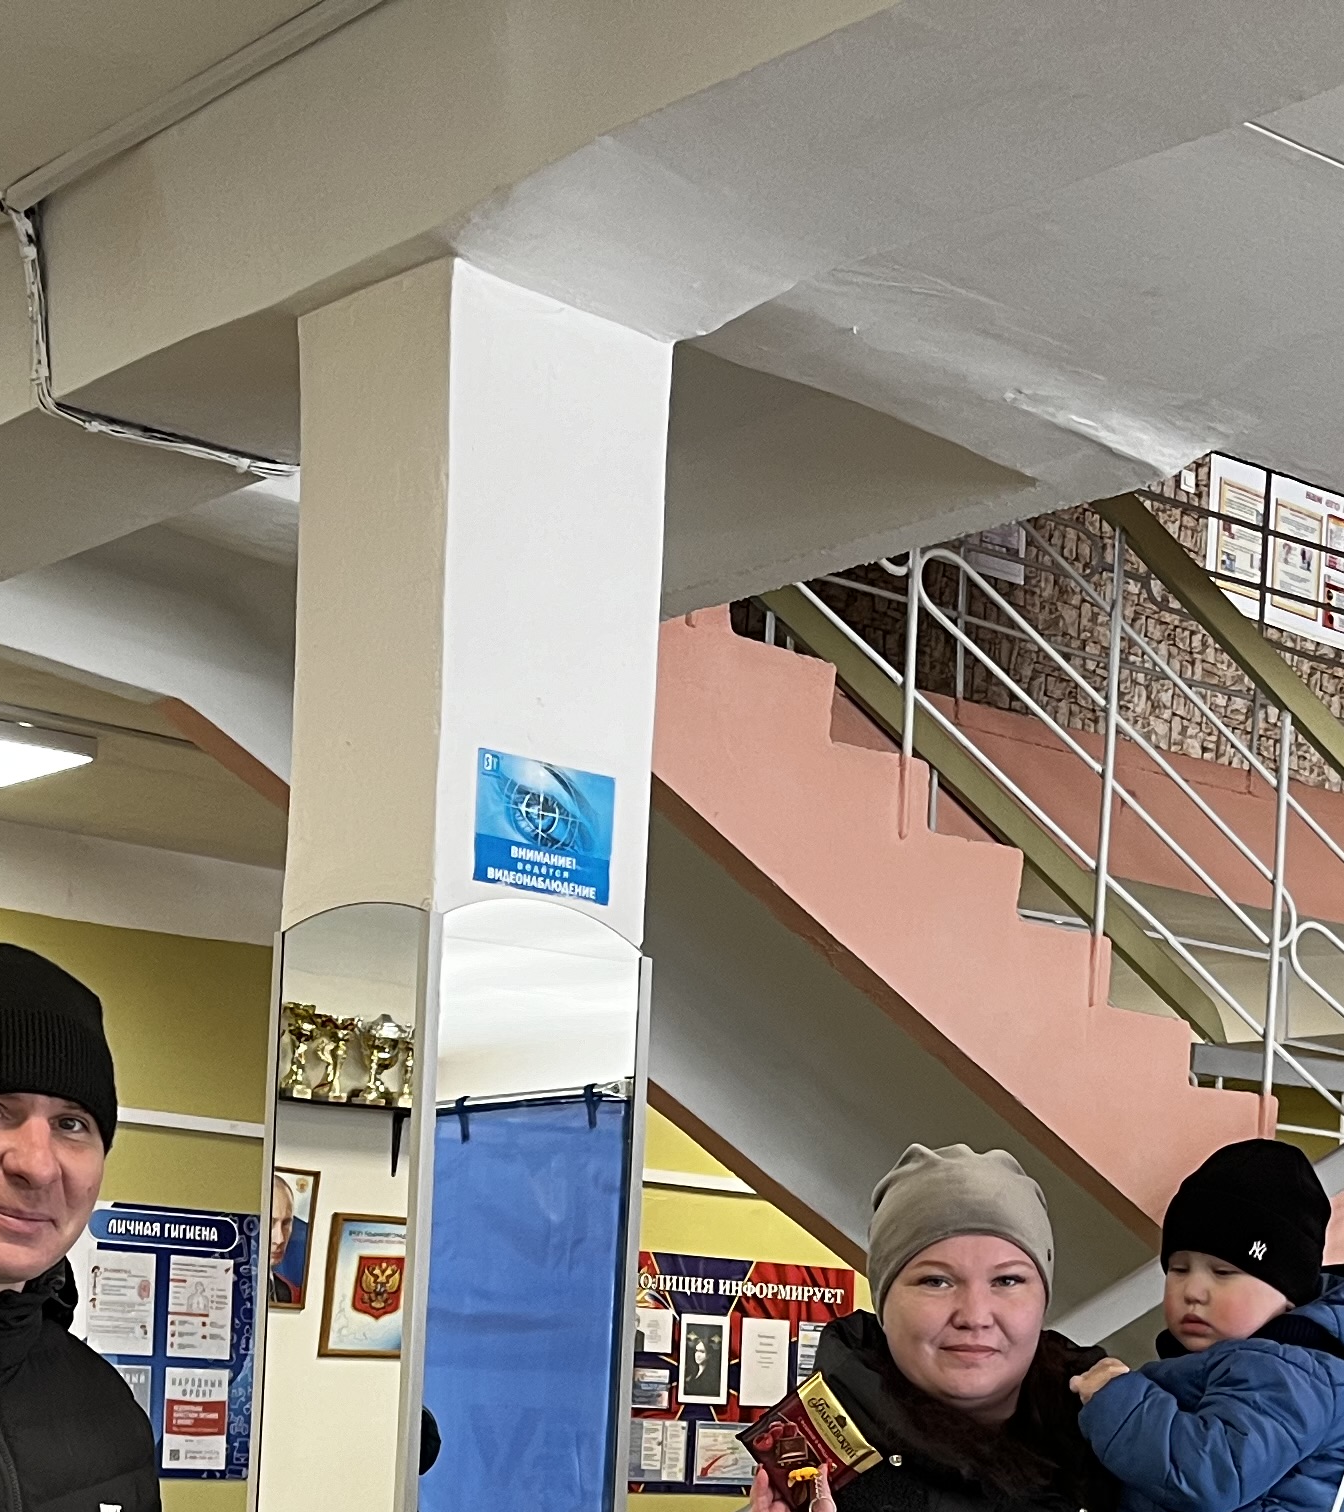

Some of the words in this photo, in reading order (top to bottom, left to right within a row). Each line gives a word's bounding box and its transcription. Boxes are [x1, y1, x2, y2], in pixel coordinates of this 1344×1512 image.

[510, 845, 576, 870] ВНИМАНИЕ!
[516, 861, 569, 879] ведётся
[487, 867, 597, 899] ВИДЕОНАБЛЮДЕНИЕ
[107, 1217, 161, 1238] ЛИЧНАЯ
[163, 1223, 219, 1242] ГИГИЕНА
[636, 1272, 715, 1297] ОЛИЦИЯ
[718, 1278, 845, 1305] ИНФОРМИРУЕТ
[171, 1377, 223, 1389] НАРОДНЫЙ
[181, 1388, 213, 1398] ФРОНТ
